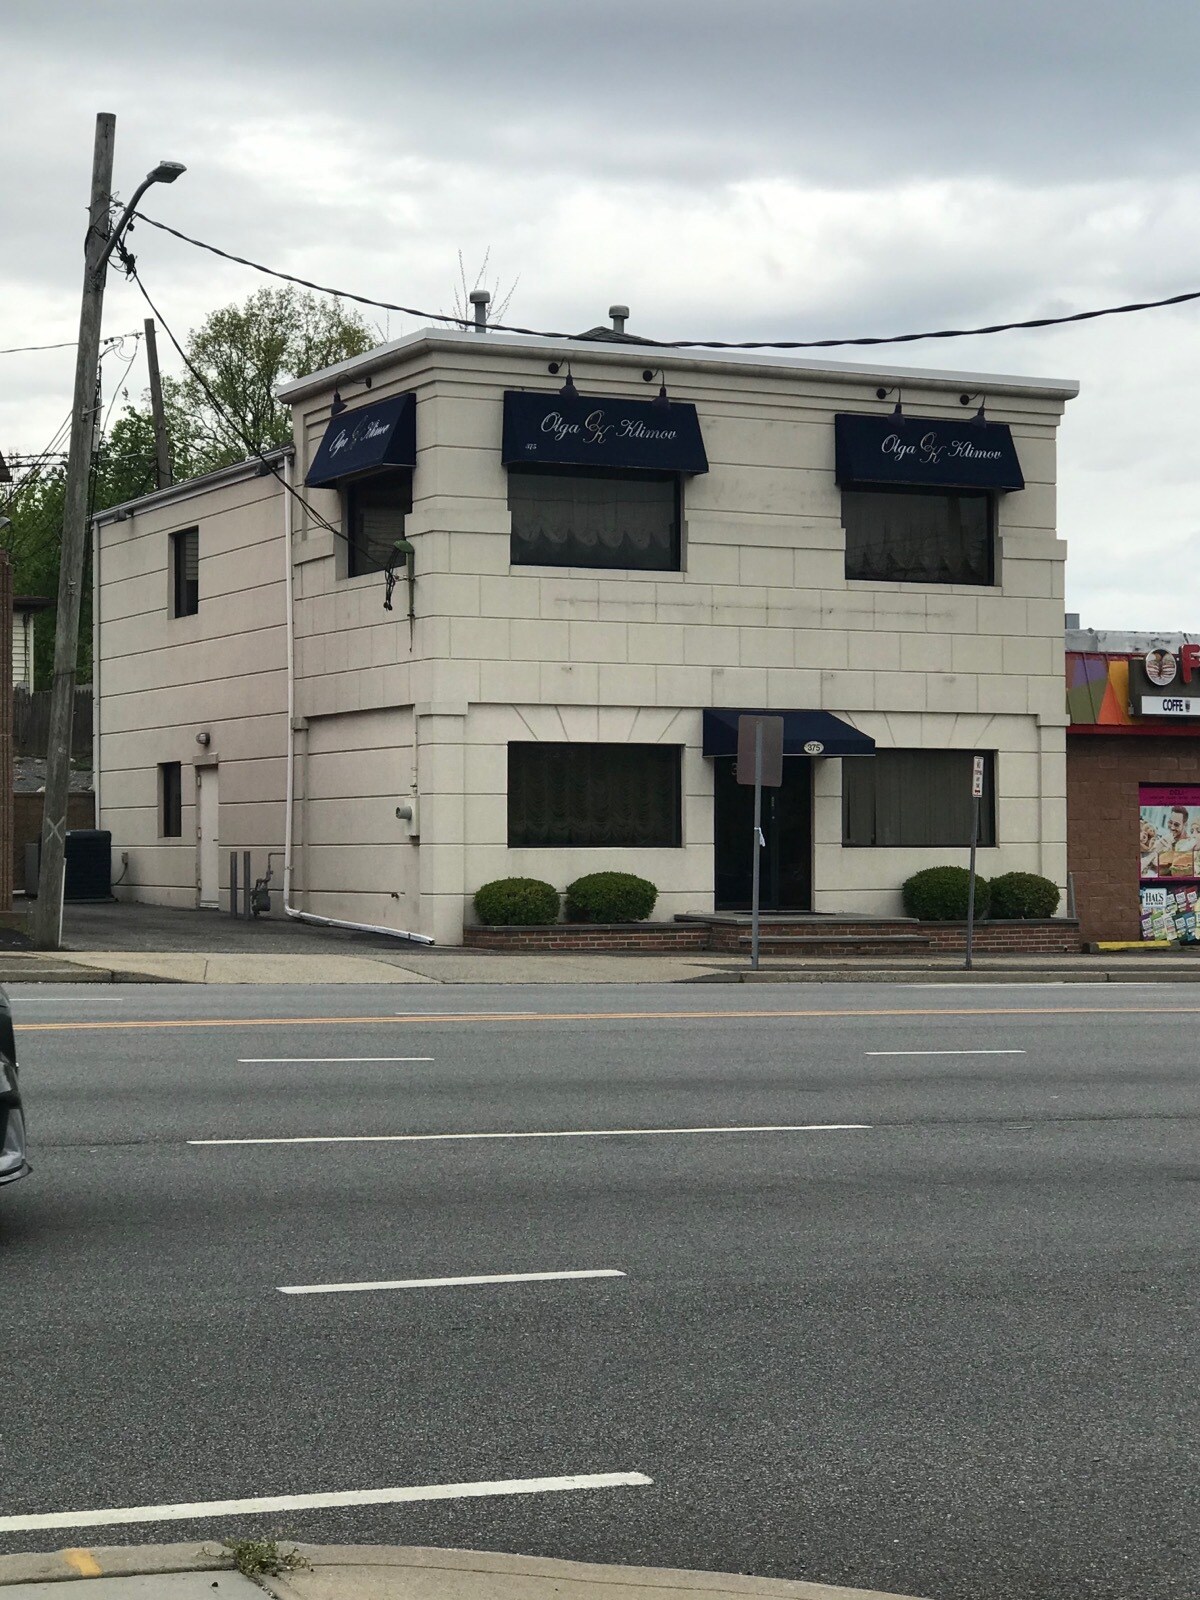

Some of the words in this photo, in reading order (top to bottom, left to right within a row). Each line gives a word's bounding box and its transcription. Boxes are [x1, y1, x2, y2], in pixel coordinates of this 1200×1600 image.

[540, 411, 580, 441] Olga
[615, 419, 677, 439] Klimov
[881, 433, 917, 461] Olga
[947, 440, 1002, 460] Klimov
[1162, 698, 1184, 712] COFFE
[806, 742, 821, 752] 375
